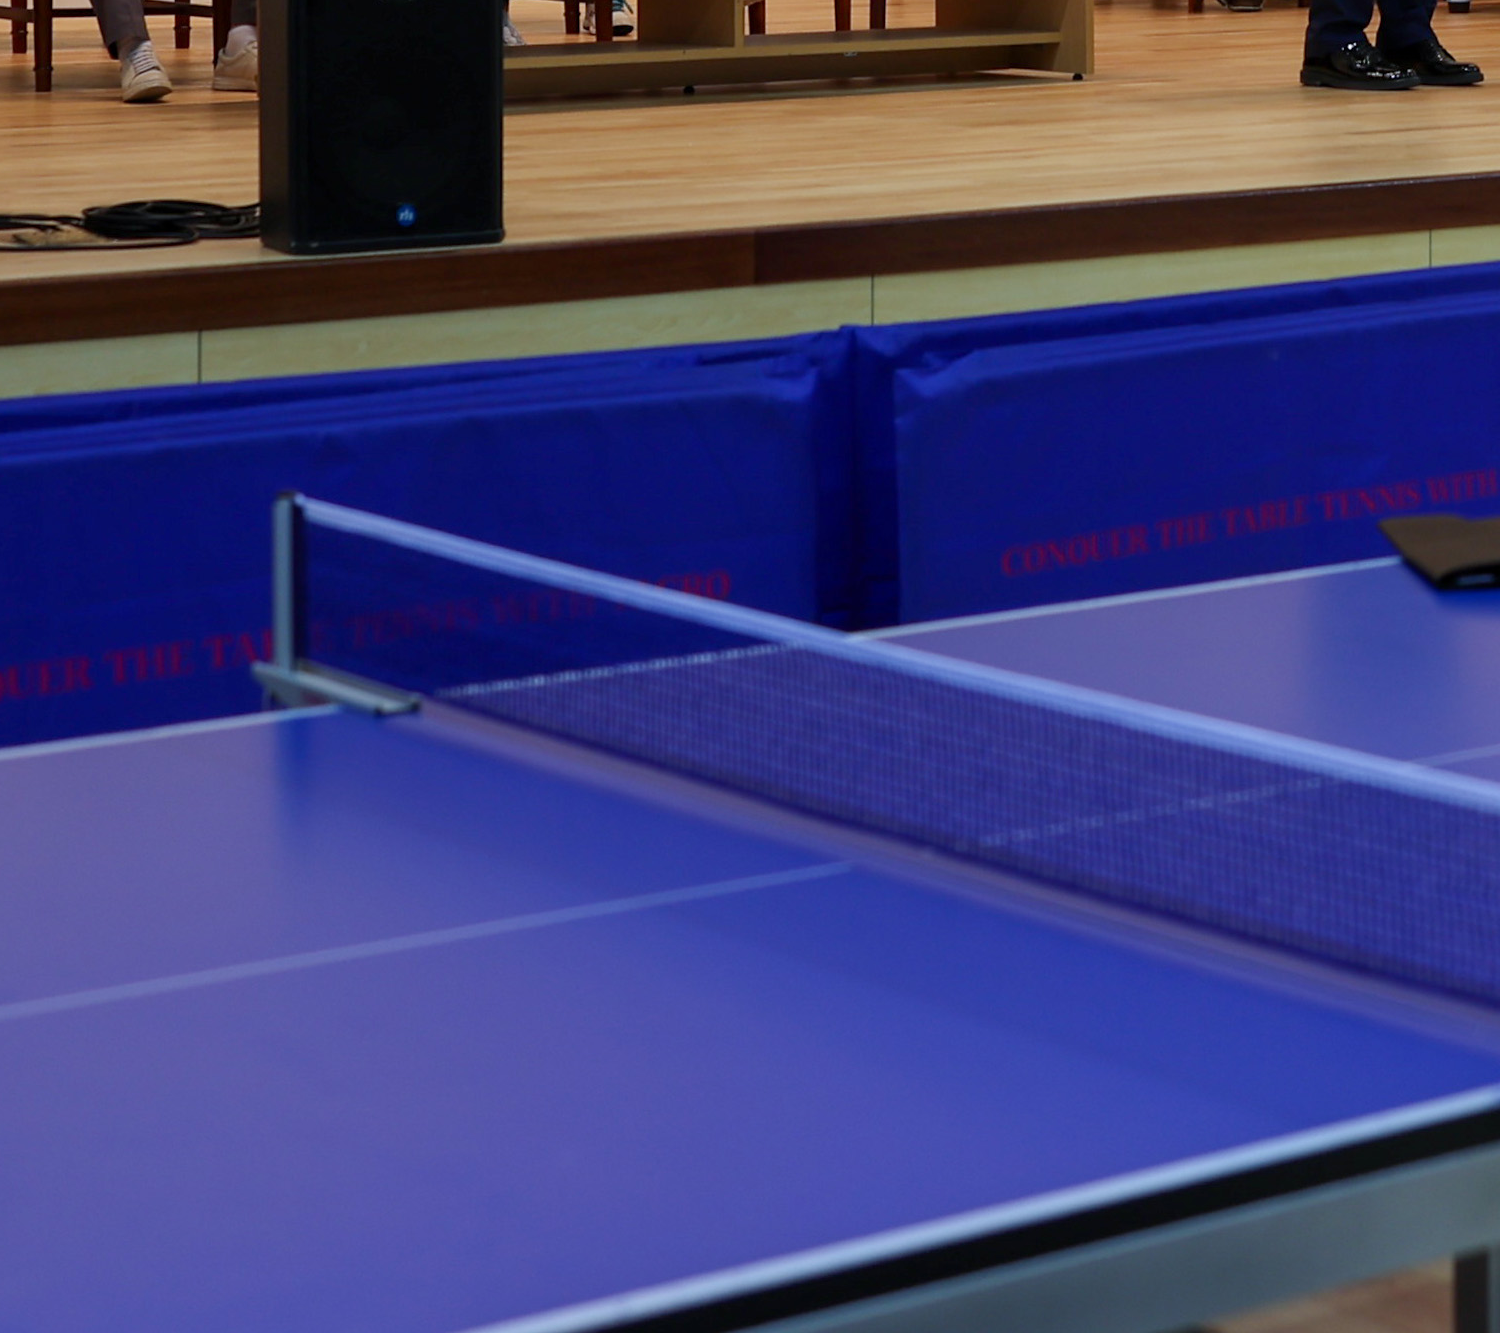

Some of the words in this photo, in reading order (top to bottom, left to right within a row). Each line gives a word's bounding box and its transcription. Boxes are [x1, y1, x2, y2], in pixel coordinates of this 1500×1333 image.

[1001, 523, 1150, 578] CONQUER
[1155, 513, 1216, 552] THE
[1220, 495, 1310, 539] TABLE
[1316, 479, 1422, 523] TENNIS
[1426, 468, 1498, 504] WITH
[102, 637, 194, 687] THE
